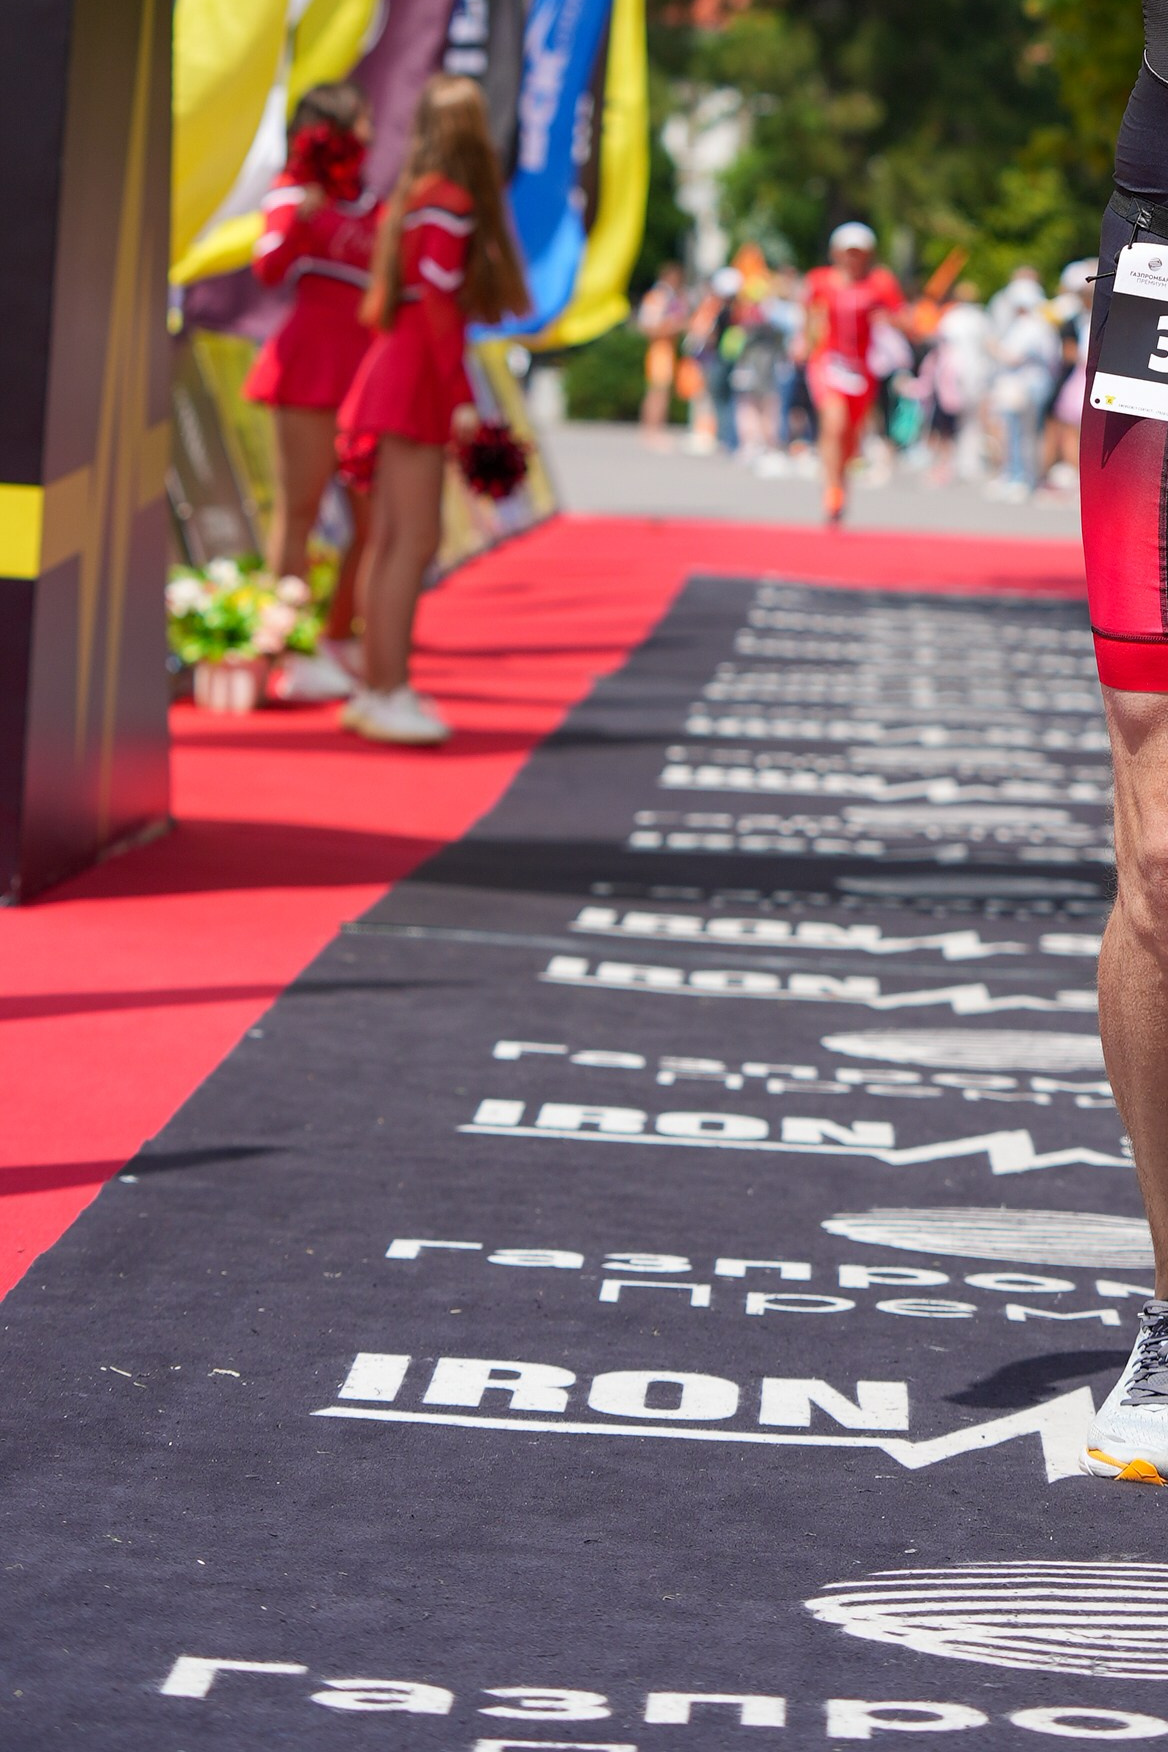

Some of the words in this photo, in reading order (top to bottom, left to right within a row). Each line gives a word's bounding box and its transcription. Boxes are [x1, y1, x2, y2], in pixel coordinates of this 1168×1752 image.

[1136, 277, 1167, 288] ПРЕМИУМ
[577, 906, 880, 947] IRON
[547, 955, 880, 999] IRON
[472, 1098, 897, 1148] IRON
[337, 1352, 909, 1432] IRON
